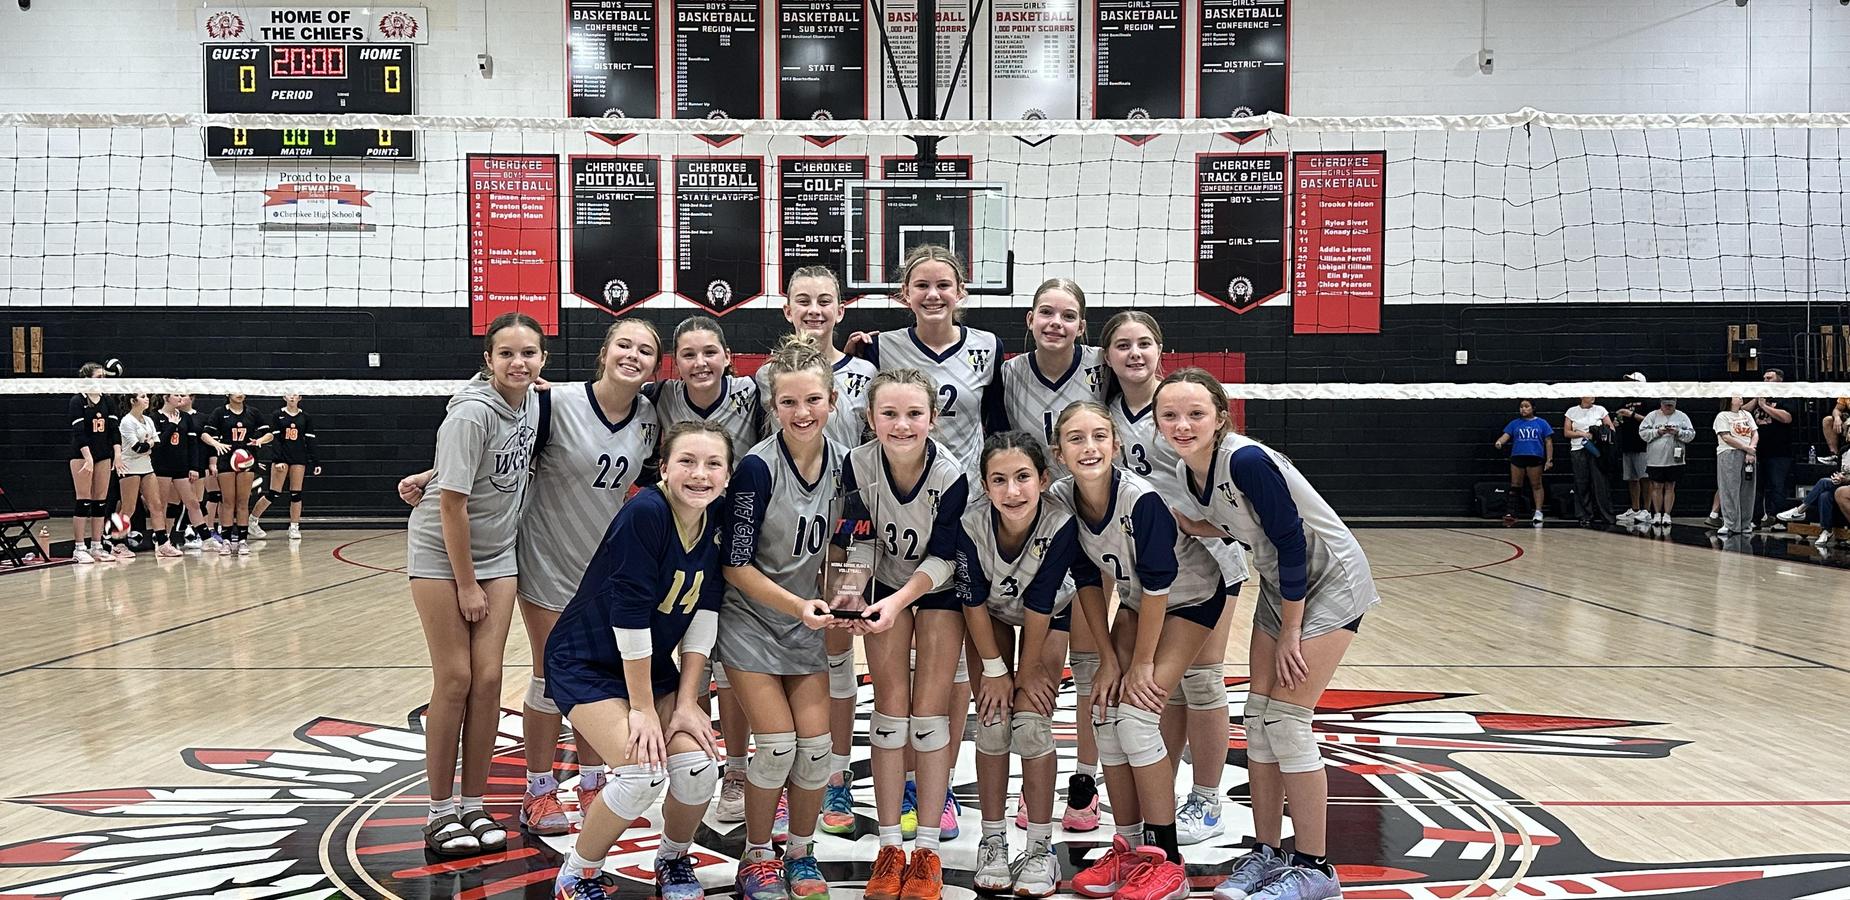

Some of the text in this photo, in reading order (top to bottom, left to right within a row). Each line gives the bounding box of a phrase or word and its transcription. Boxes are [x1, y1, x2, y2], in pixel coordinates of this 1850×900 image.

[271, 10, 351, 24] HOME OF
[574, 10, 651, 20] BASKETBALL
[678, 12, 755, 22] BASKETBALL
[783, 12, 860, 22] BASKETBALL
[888, 12, 965, 22] BASKBALL
[996, 12, 1074, 22] BASKETBALL
[1101, 10, 1178, 20] BASKETBALL
[1205, 8, 1283, 19] BASKETBALL
[260, 27, 364, 40] THE CHIEFS
[211, 48, 260, 60] GUEST
[359, 48, 402, 60] HOME
[272, 48, 344, 75] 20:00
[239, 66, 256, 92] 0
[384, 66, 400, 93] 0
[271, 90, 314, 100] PERIOD
[222, 148, 254, 156] POINTS
[280, 148, 312, 156] MATCH
[366, 148, 399, 156] POINTS
[484, 160, 543, 170] CHEROKEE
[586, 163, 644, 172] CHEROKEE
[688, 163, 746, 172] CHEROKEE
[794, 163, 852, 172] CHEROKEE
[898, 162, 956, 172] CHEKEE
[1213, 160, 1271, 170] CHEROKEE
[1310, 158, 1369, 167] CHEROKEE
[280, 172, 311, 182] Proud
[315, 173, 326, 182] to
[330, 172, 342, 182] be
[576, 173, 654, 186] FOOTBALL
[680, 173, 757, 186] FOOTBALL
[1200, 172, 1283, 182] TRACK & FIELD
[476, 181, 552, 191] BASKETBALL
[804, 179, 843, 191] GOLF
[1301, 179, 1378, 188] BASKETBALL
[490, 294, 546, 302] Grayson Hughes
[232, 428, 246, 442] 17
[1519, 428, 1538, 438] NYC
[592, 453, 629, 490] 22
[792, 514, 826, 556] 10
[885, 522, 920, 562] 32
[1102, 553, 1130, 582] 2
[657, 570, 704, 614] 14
